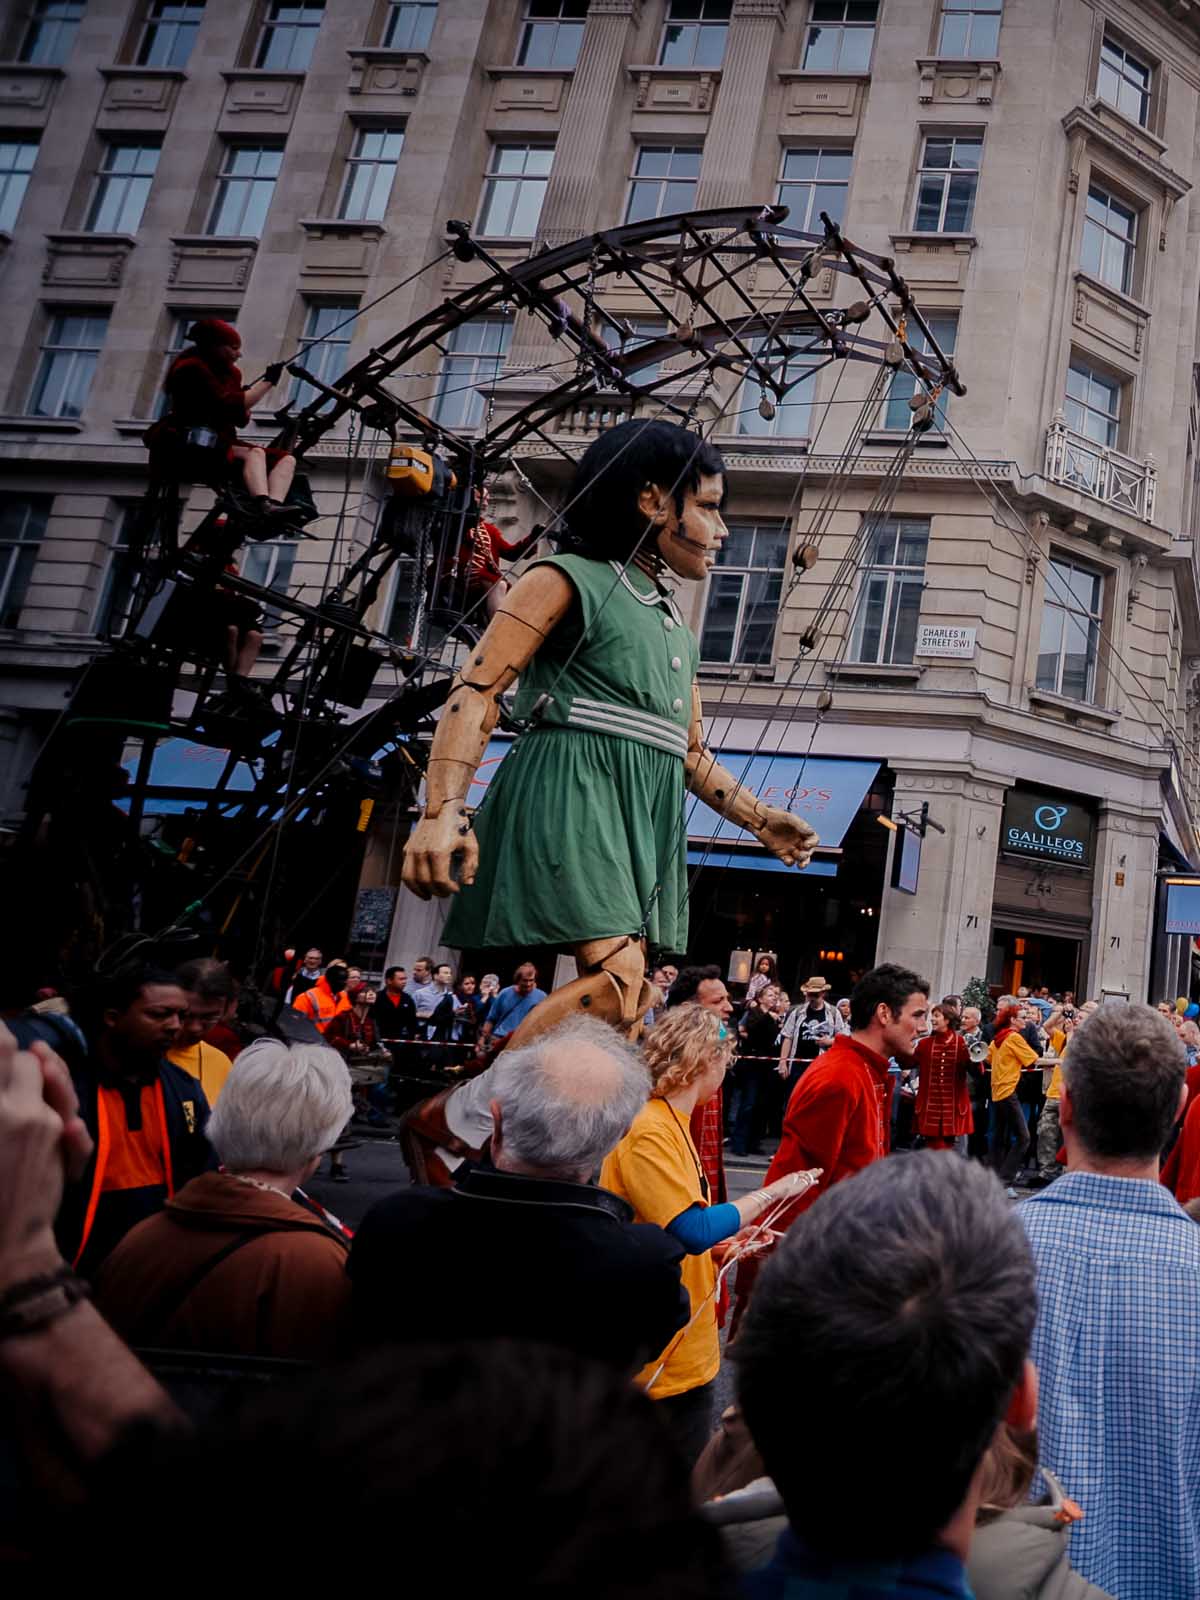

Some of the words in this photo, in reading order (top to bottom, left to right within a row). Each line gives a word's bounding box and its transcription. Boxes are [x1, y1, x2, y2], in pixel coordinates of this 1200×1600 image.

[923, 628, 959, 638] CHARLES
[960, 631, 966, 639] II
[921, 637, 951, 647] STREET
[953, 639, 970, 648] SW1
[1008, 827, 1085, 852] GALILEO'S
[966, 915, 979, 929] 71
[1110, 936, 1121, 949] 71
